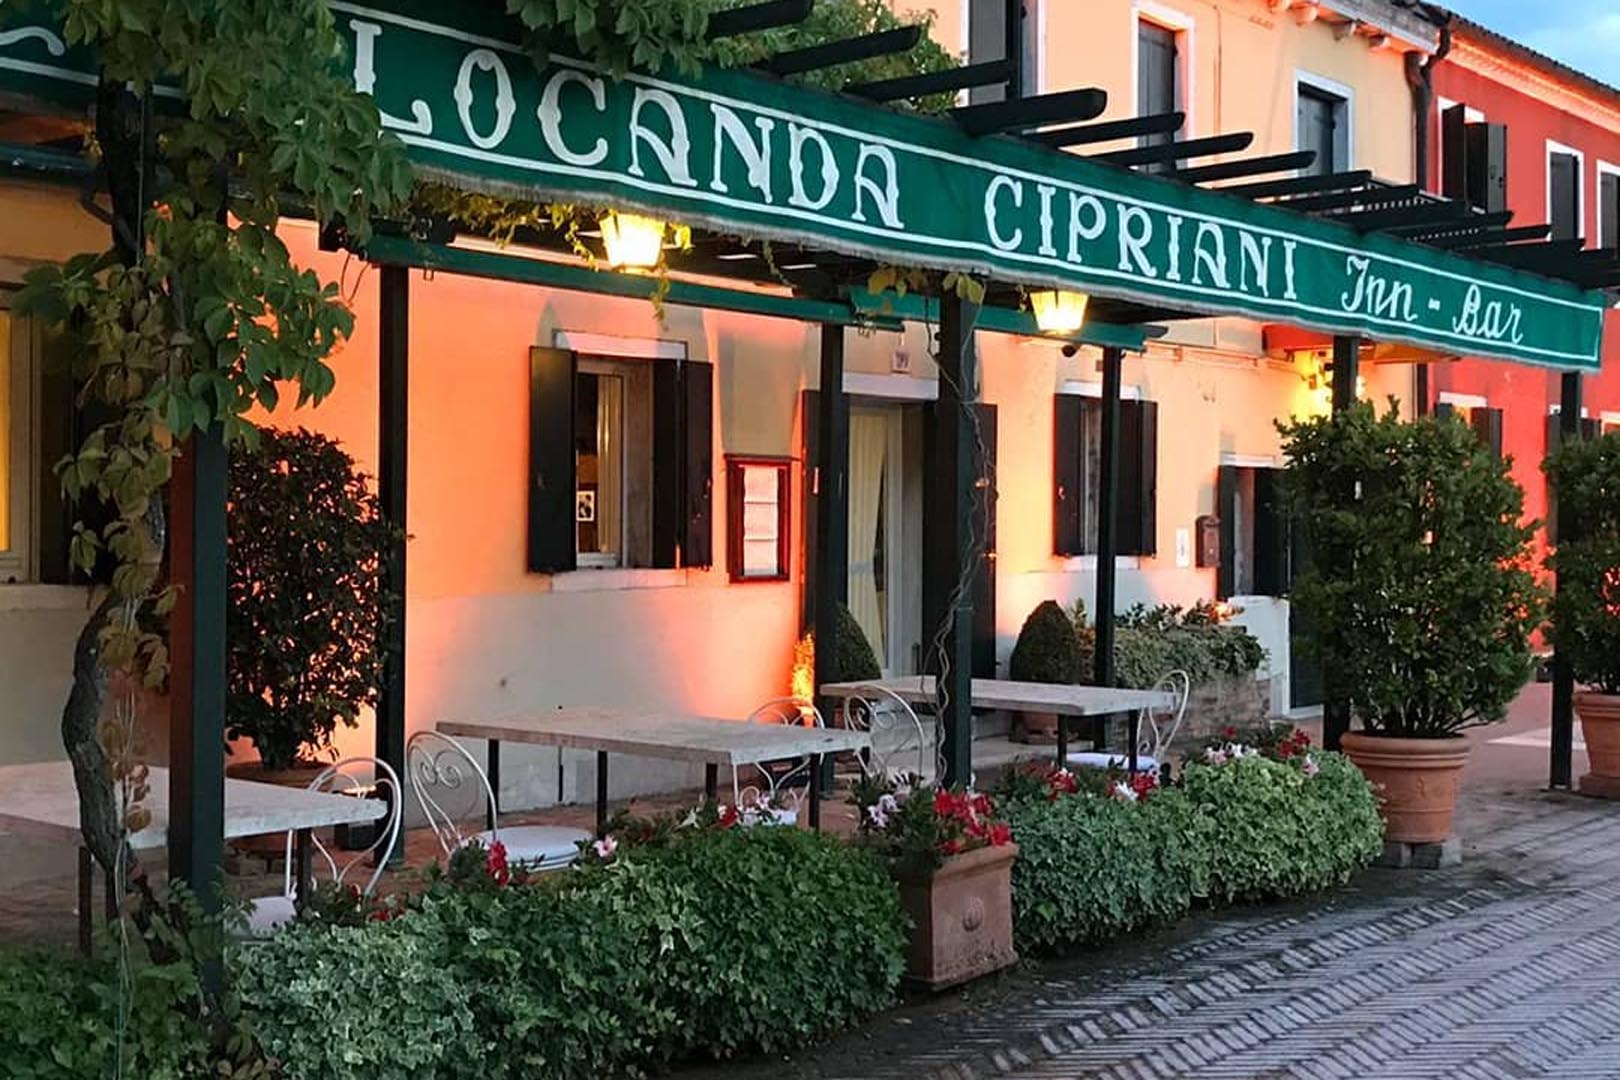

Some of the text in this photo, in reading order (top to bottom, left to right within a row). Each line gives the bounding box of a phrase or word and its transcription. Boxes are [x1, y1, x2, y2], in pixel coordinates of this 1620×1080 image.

[351, 21, 903, 229] LOCANDA
[985, 175, 1297, 300] CIPRIANI
[1342, 256, 1418, 322] Inn
[1453, 284, 1524, 344] Bar
